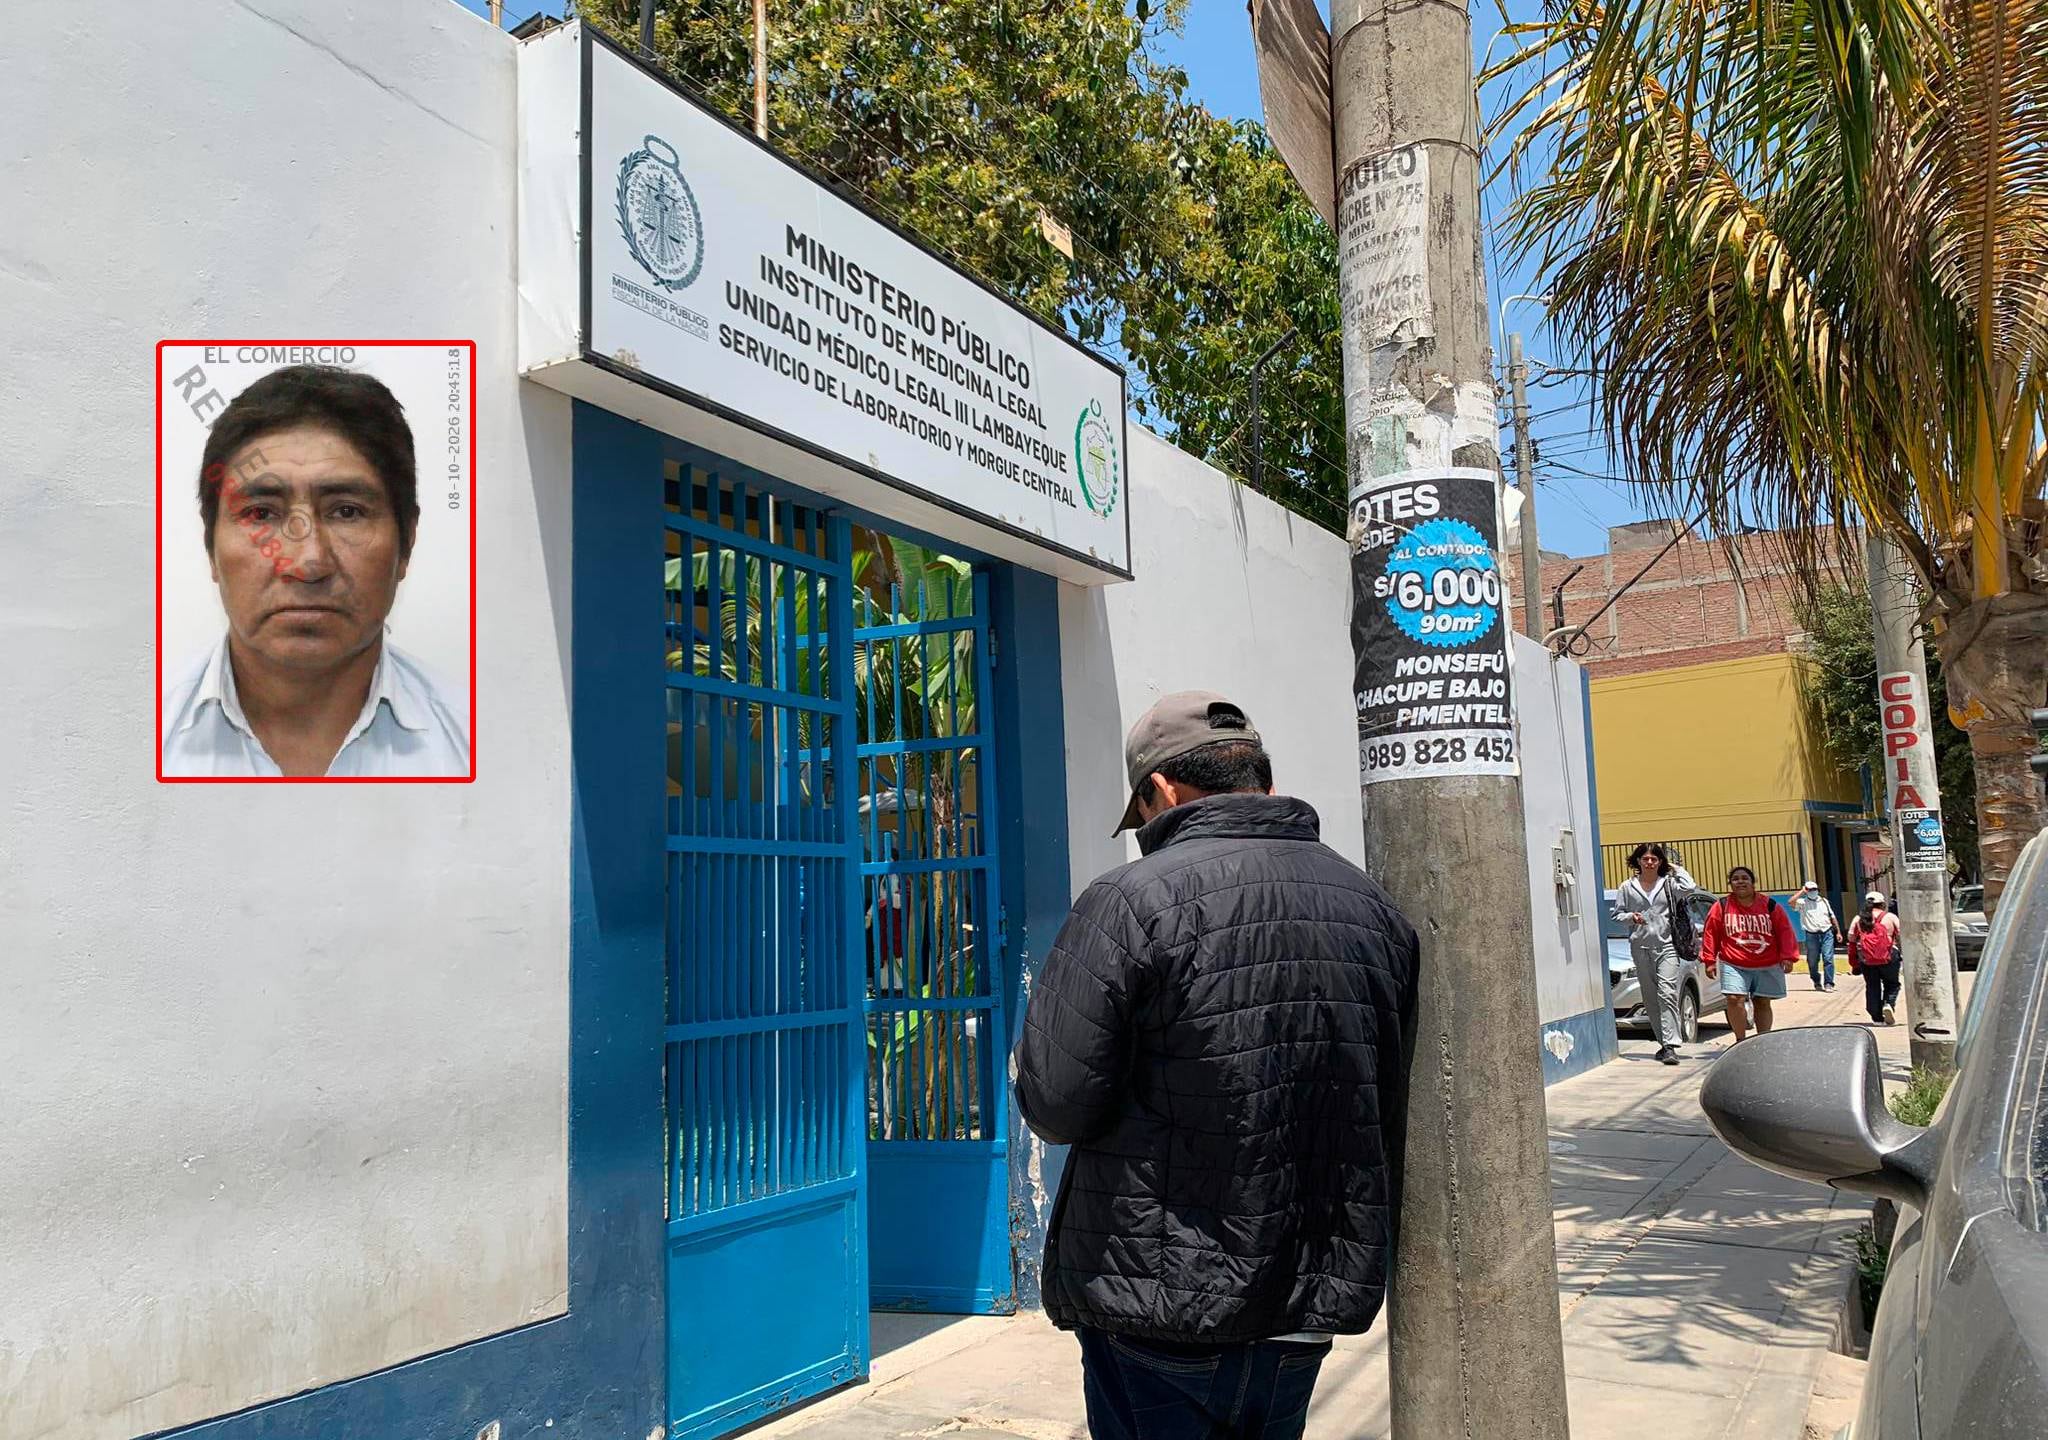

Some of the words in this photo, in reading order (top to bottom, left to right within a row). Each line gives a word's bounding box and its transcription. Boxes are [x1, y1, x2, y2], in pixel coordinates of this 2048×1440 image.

[612, 275, 668, 310] MINISTERIO
[786, 223, 936, 337] MINISTERIO
[941, 315, 1030, 390] PÚBLICO
[760, 254, 877, 340] INSTITUTO
[881, 322, 908, 357] DE
[911, 338, 995, 403] MEDICINA
[998, 385, 1048, 431] LEGAL
[725, 279, 812, 346] UNIDAD
[816, 327, 890, 386] MÉDICO
[894, 367, 952, 418] LEGAL
[954, 398, 969, 426] III
[972, 407, 1068, 473] LAMBAYEQUE
[719, 323, 810, 385] SERVICIO
[814, 368, 838, 399] DE
[842, 381, 952, 451] LABORATORIO
[954, 435, 964, 457] Y
[967, 441, 1020, 483] MORGUE
[1022, 468, 1077, 508] CENTRAL
[1394, 547, 1412, 560] AL
[1394, 650, 1504, 678] MONSEFÚ
[1357, 680, 1444, 710] CHACUPE
[1448, 679, 1506, 698] BAJO
[1396, 703, 1507, 727] PIMENTEL
[1368, 741, 1406, 770] 989
[1414, 738, 1467, 765] 828
[1474, 736, 1514, 763] 452
[1881, 676, 1927, 809] COPIA
[1901, 810, 1930, 819] LOTES
